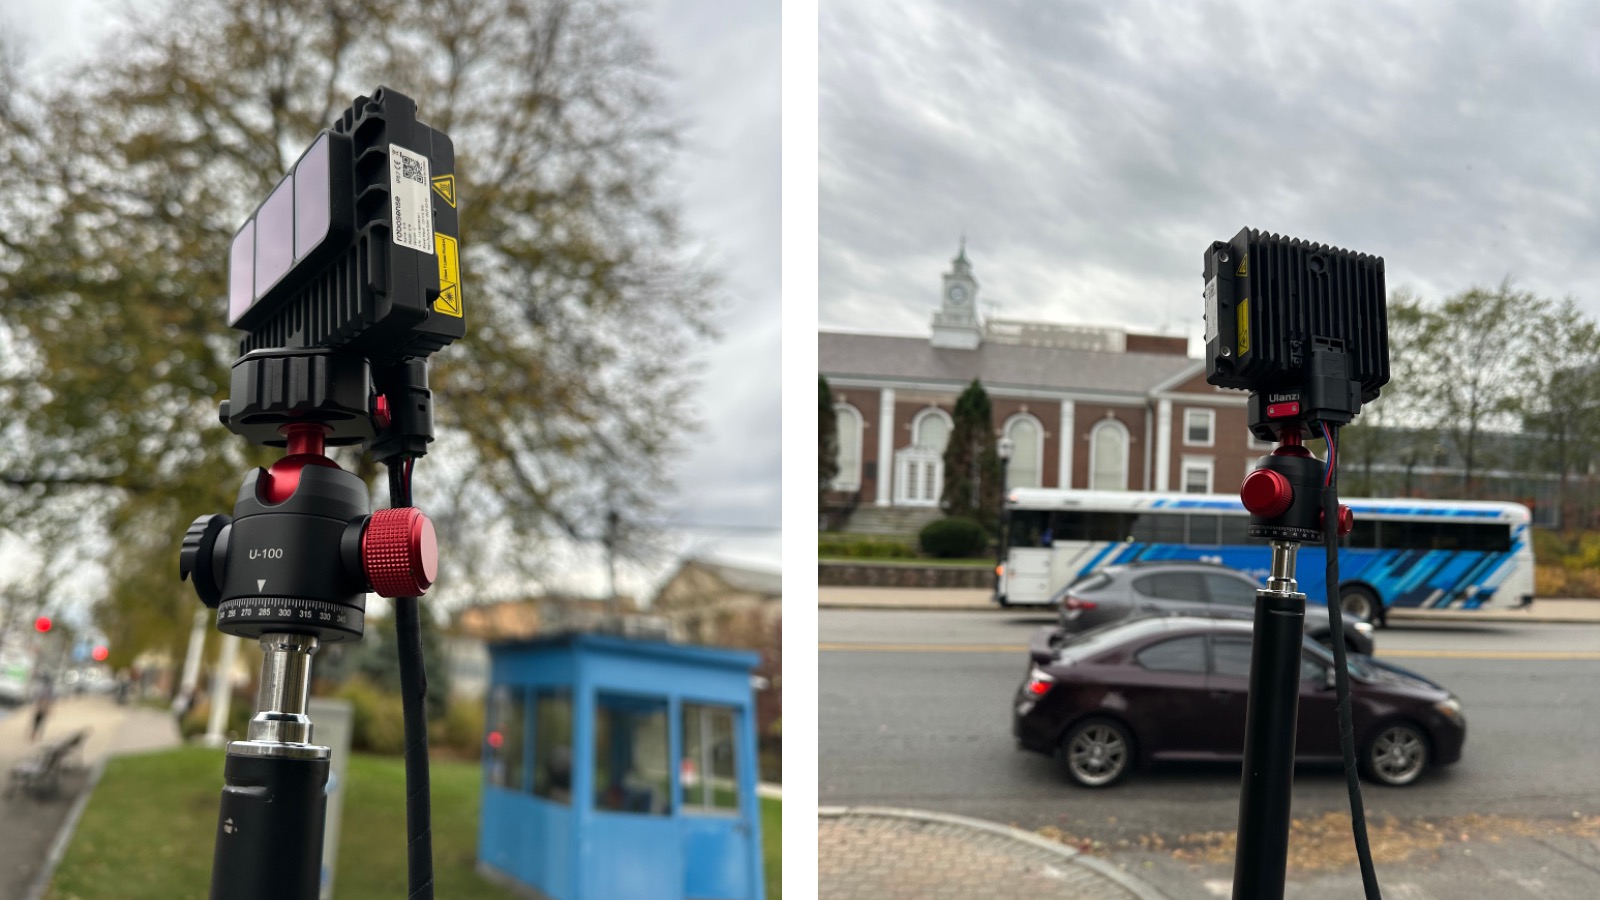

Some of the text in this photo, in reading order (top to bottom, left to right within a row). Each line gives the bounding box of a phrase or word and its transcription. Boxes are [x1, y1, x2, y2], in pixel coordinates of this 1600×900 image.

[394, 196, 402, 242] robosense
[1269, 393, 1300, 403] Ulanzi
[249, 548, 283, 560] U-100
[240, 608, 252, 617] 270
[258, 607, 271, 616] 285
[278, 608, 292, 617] 300
[299, 609, 312, 619] 315
[319, 611, 331, 621] 330
[336, 614, 346, 623] 345
